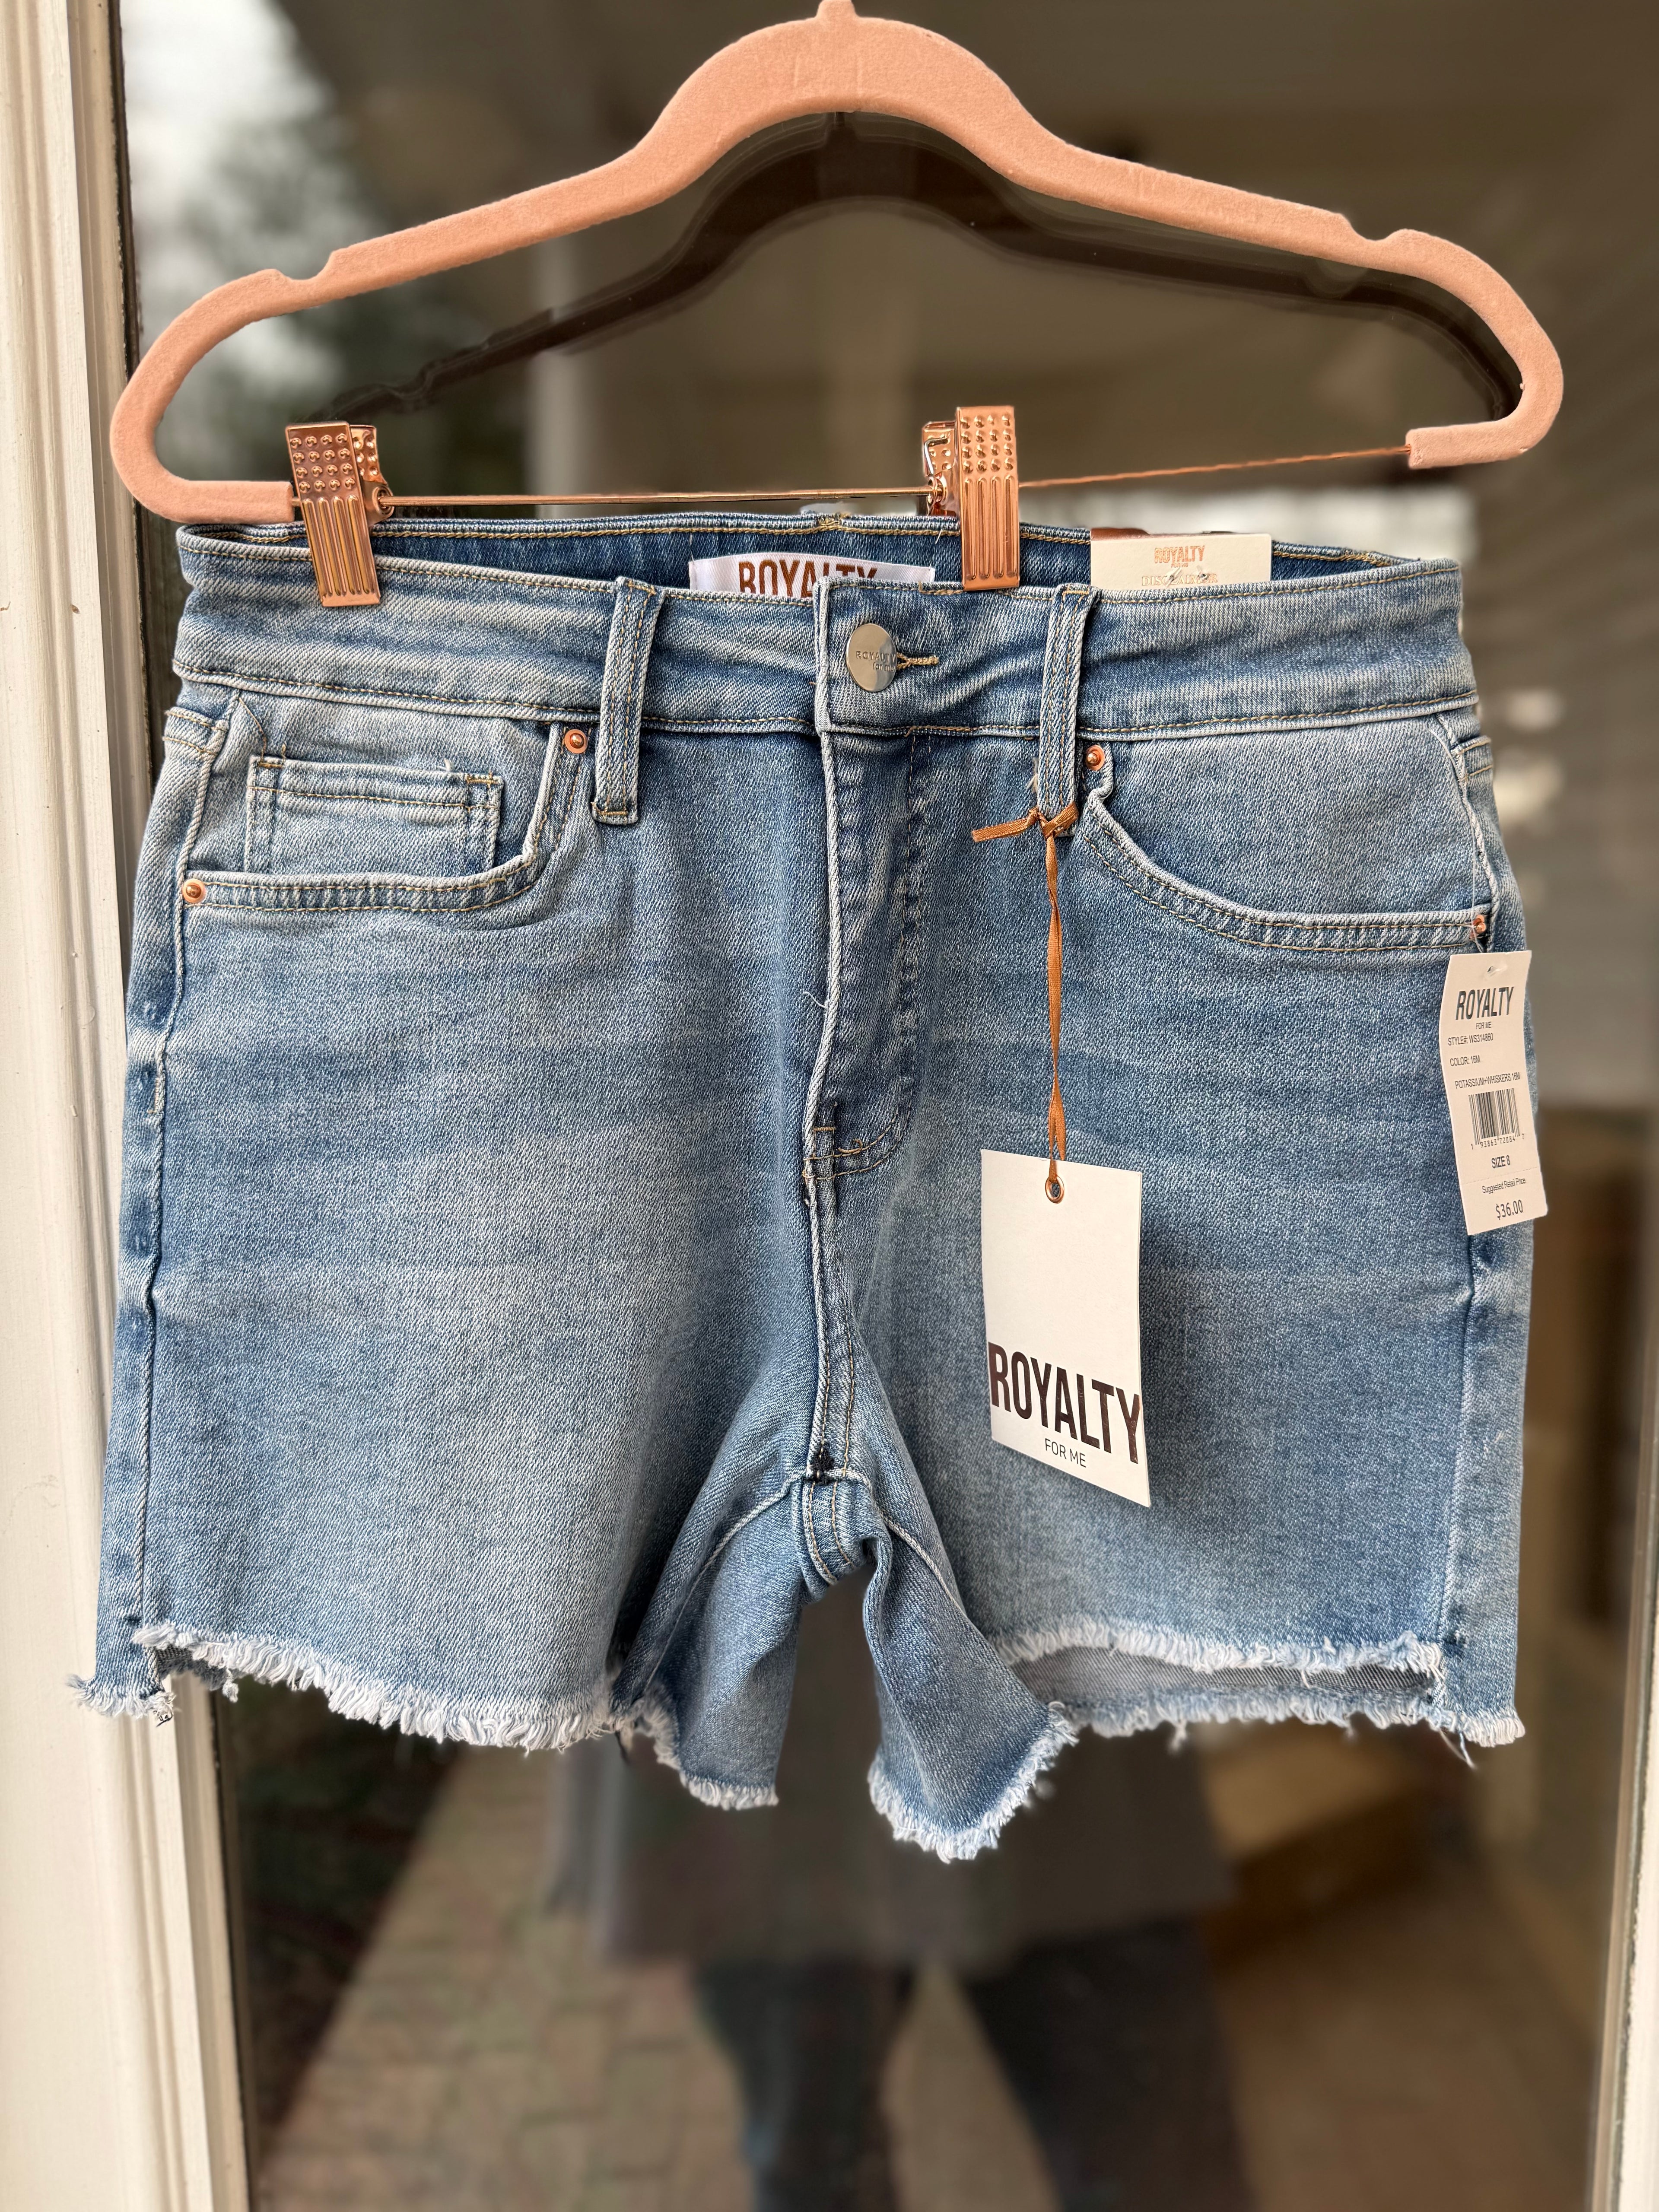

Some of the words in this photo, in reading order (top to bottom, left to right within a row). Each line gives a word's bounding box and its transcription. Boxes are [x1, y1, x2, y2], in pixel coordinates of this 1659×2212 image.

[1154, 545, 1205, 563] ROYALTY
[739, 559, 878, 598] ROYA
[856, 651, 896, 663] ROYALTY
[873, 662, 883, 670] for
[885, 664, 895, 672] me
[1456, 987, 1514, 1020] ROYALTY
[1450, 1056, 1469, 1066] COLOR:
[1471, 1055, 1481, 1064] 16M
[1455, 1073, 1511, 1089] POTASSIUM+WHISKERS
[1512, 1072, 1520, 1081] 16M
[1480, 1139, 1497, 1148] 93863
[1499, 1135, 1516, 1144] 72084
[1491, 1156, 1506, 1169] SIZE
[1506, 1155, 1510, 1166] 8
[1482, 1182, 1504, 1194] Suggested
[1504, 1179, 1516, 1188] Retail
[1496, 1199, 1523, 1220] $36.00
[988, 1341, 1141, 1464] ROYALTY
[1045, 1438, 1067, 1459] FOR
[1070, 1448, 1087, 1468] ME
